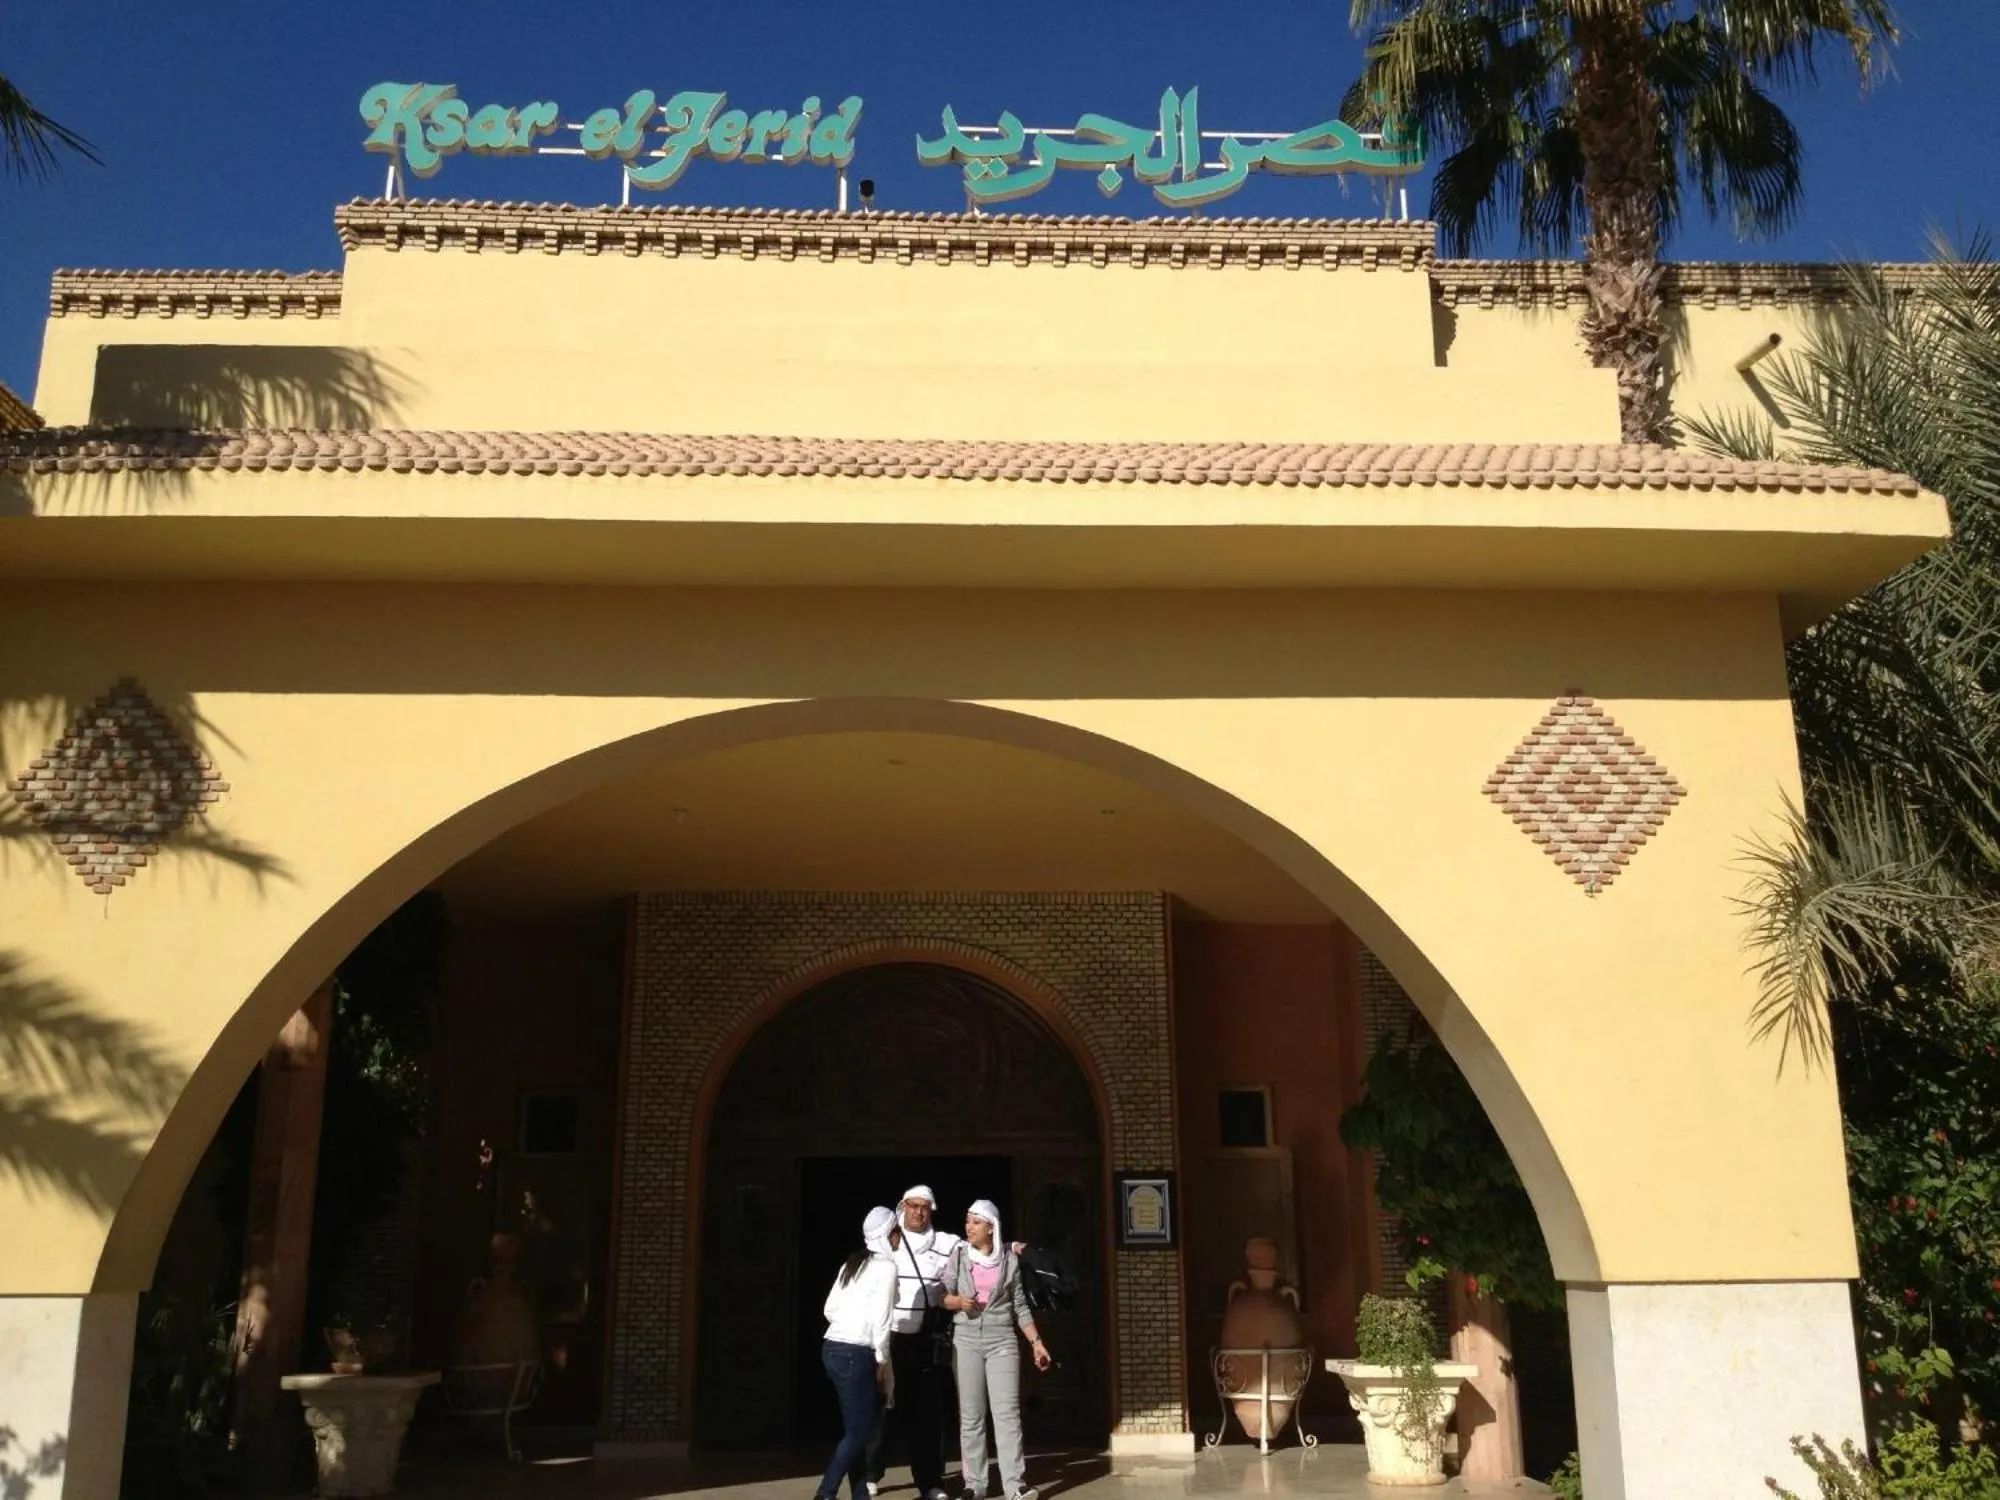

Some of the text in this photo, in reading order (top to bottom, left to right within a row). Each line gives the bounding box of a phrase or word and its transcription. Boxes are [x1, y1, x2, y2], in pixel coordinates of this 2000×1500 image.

[360, 82, 864, 191] Ksar el Jerid
[916, 85, 1201, 203] الجريد
